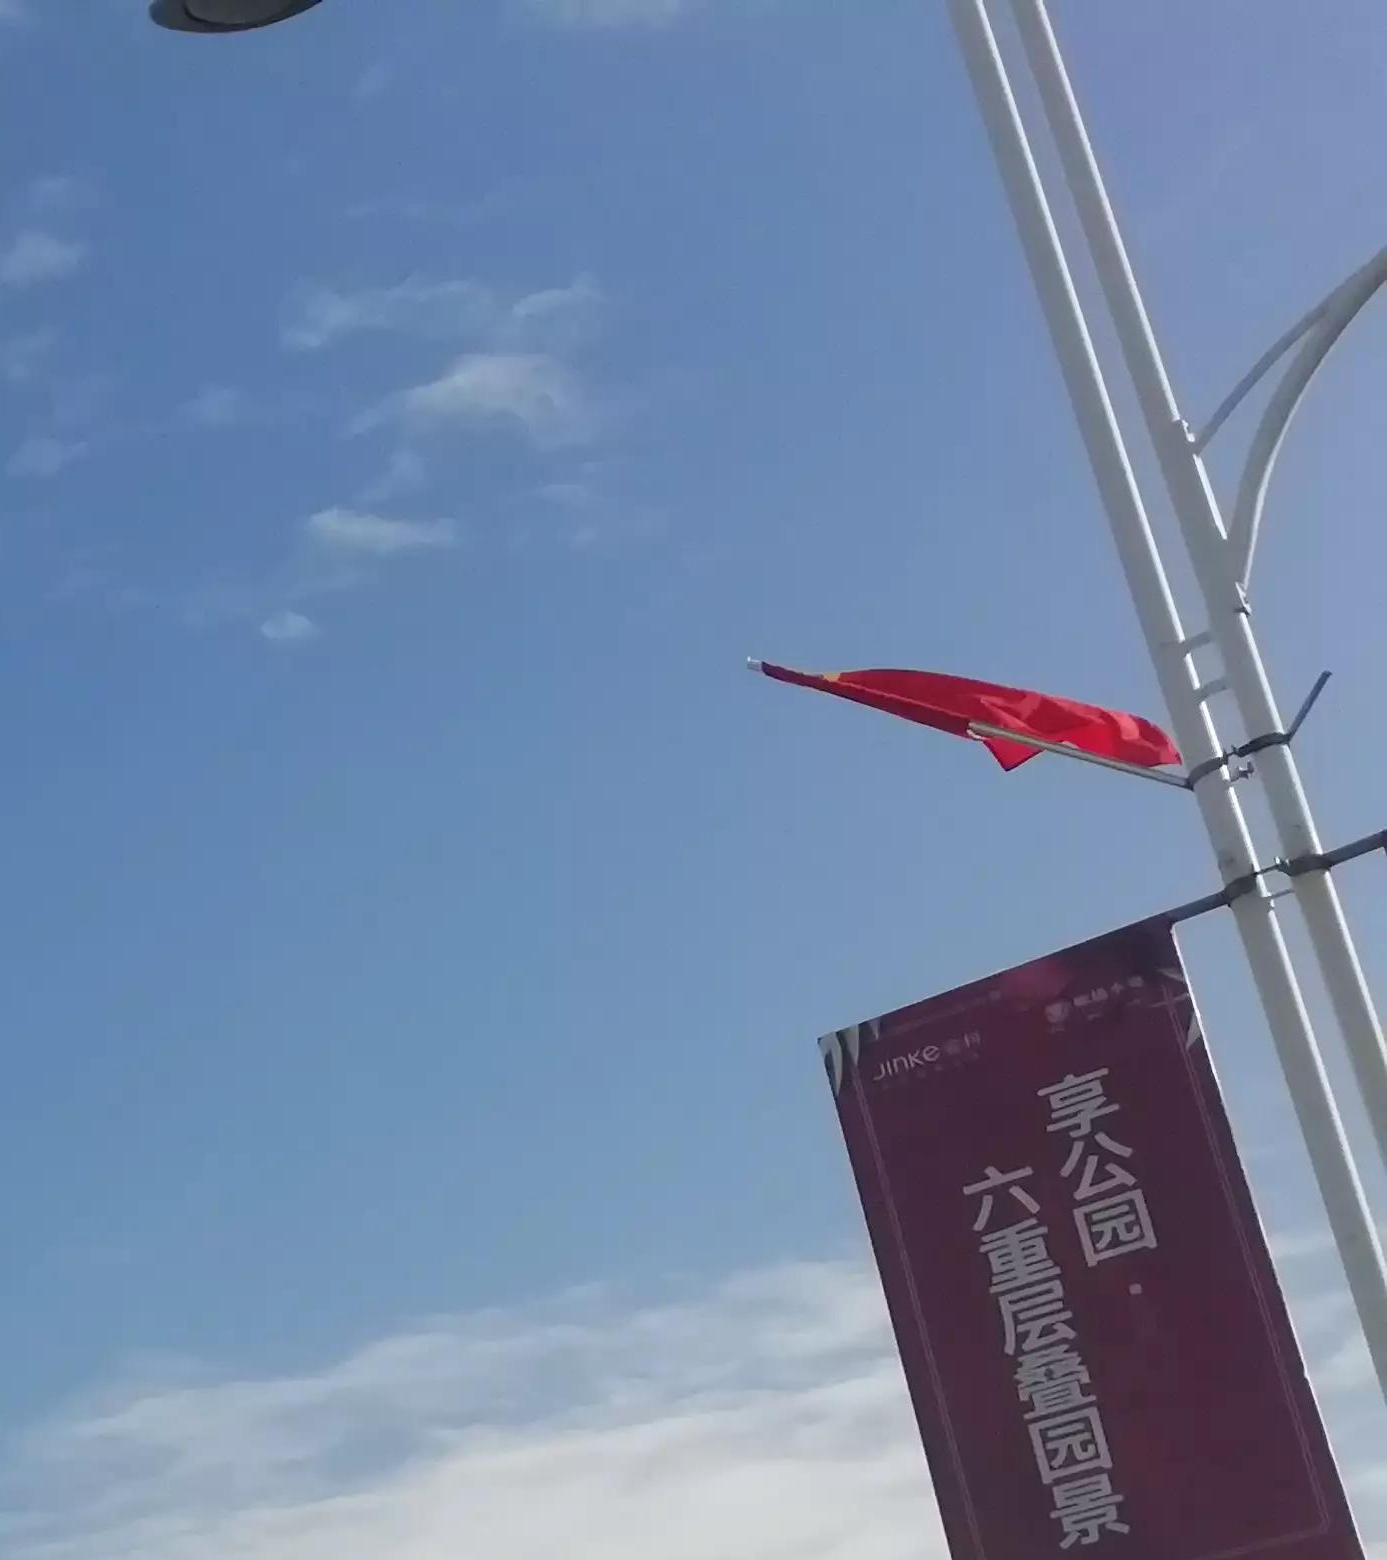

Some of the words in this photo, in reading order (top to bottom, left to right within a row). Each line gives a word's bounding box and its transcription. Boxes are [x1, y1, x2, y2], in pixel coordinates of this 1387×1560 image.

[963, 1166, 1129, 1549] 六重层叠园景
